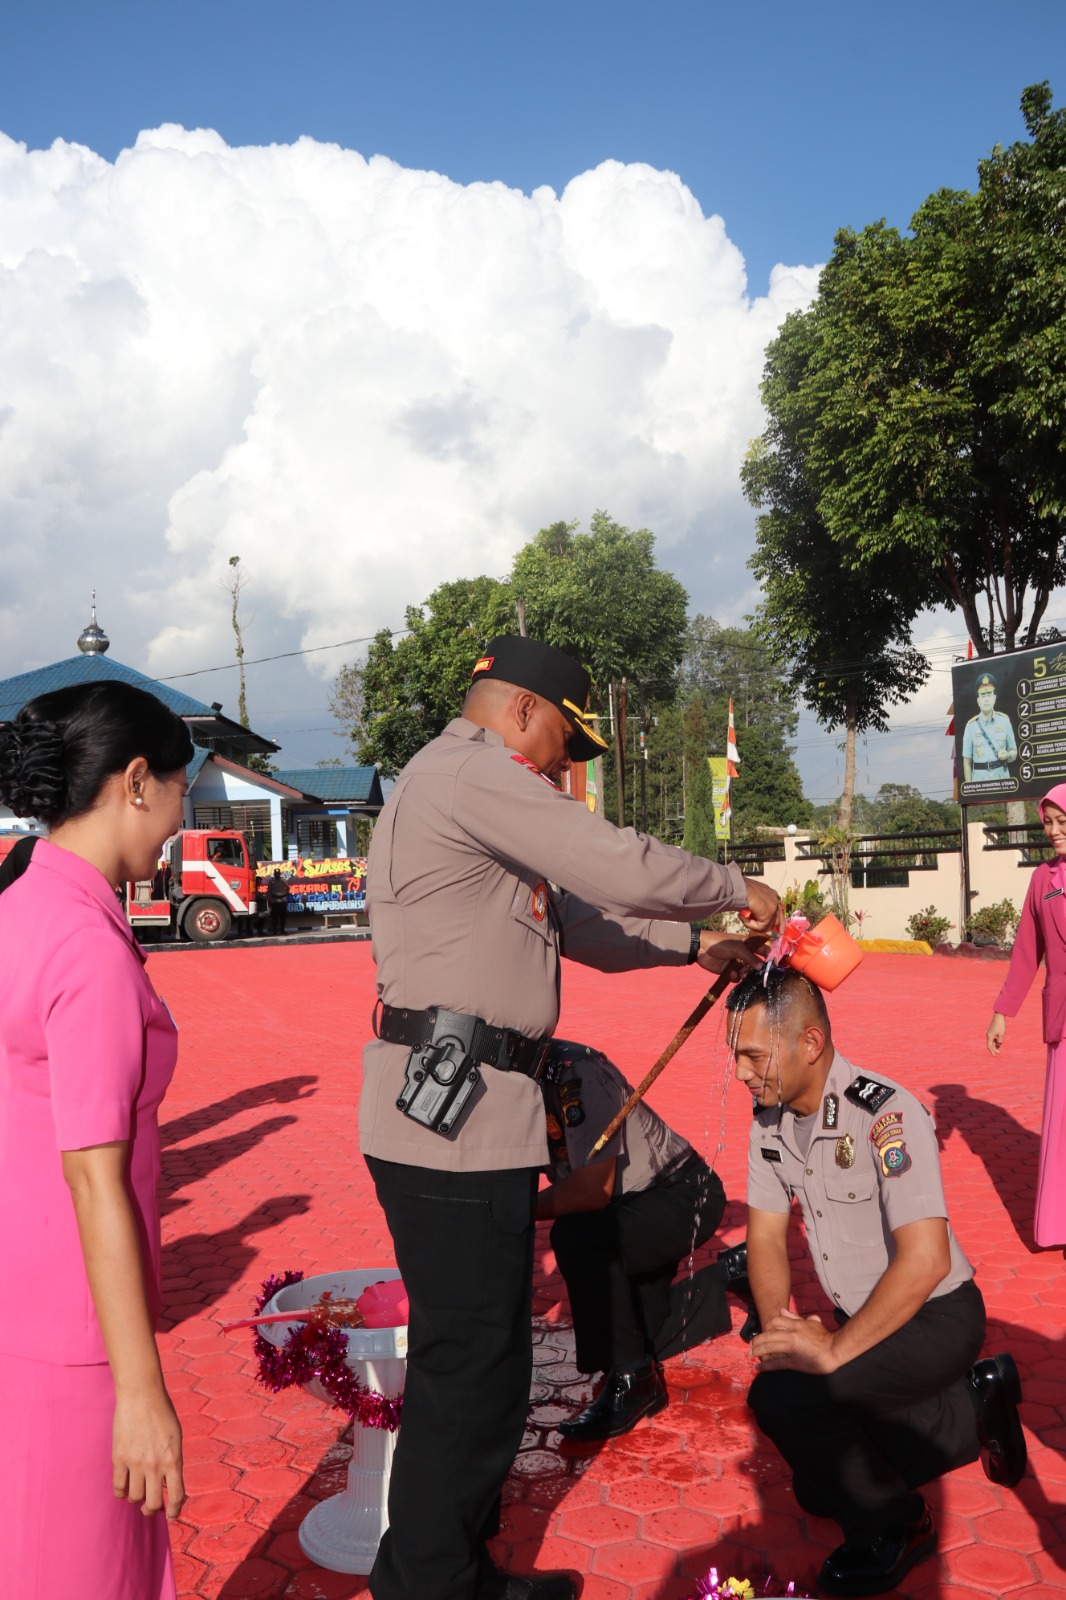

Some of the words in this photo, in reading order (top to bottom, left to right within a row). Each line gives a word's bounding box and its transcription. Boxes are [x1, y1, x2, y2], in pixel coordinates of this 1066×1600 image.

[1033, 657, 1047, 678] 5
[1020, 683, 1026, 695] 1
[1020, 703, 1029, 717] 2
[1020, 724, 1030, 737] 3
[1022, 745, 1030, 758] 4
[1022, 766, 1031, 779] 5
[346, 877, 360, 891] 79
